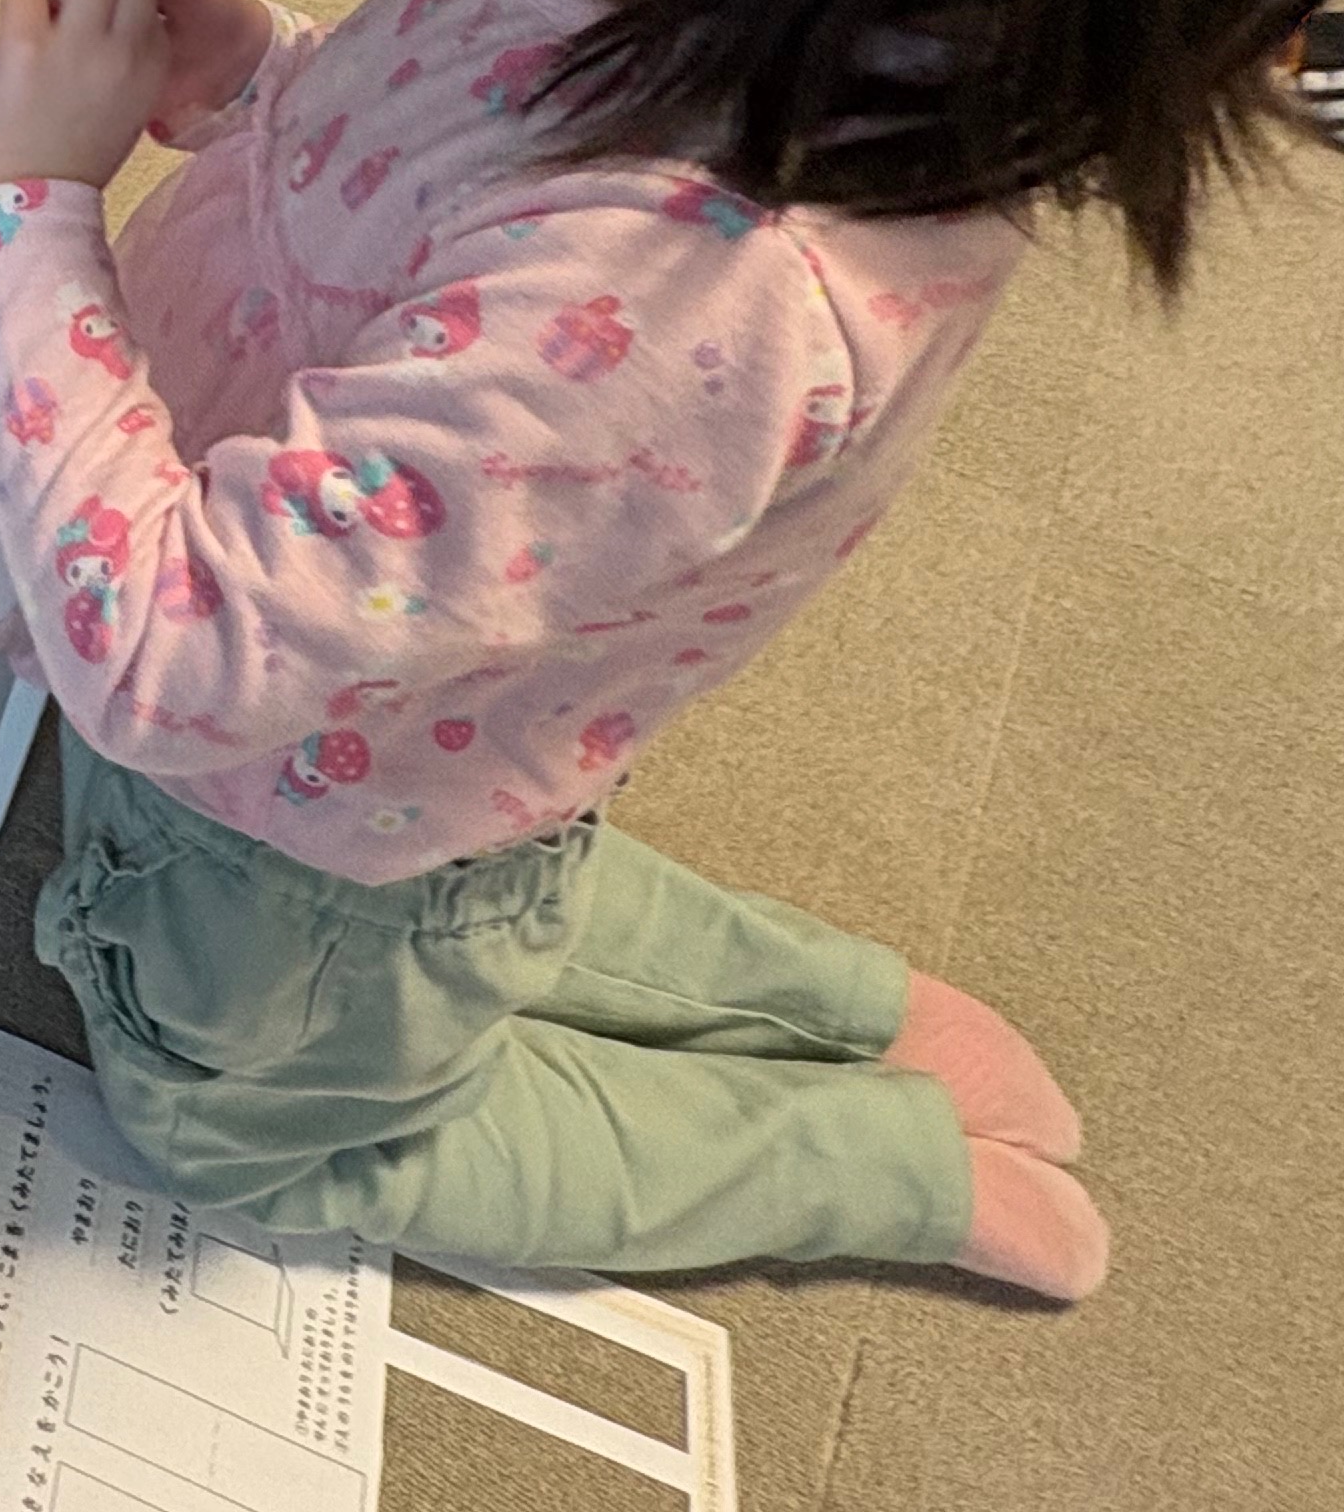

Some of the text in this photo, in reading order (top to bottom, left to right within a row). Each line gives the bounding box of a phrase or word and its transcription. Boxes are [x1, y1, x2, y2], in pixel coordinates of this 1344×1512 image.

[72, 1178, 98, 1246] やまおり
[117, 1200, 144, 1270] たにおり
